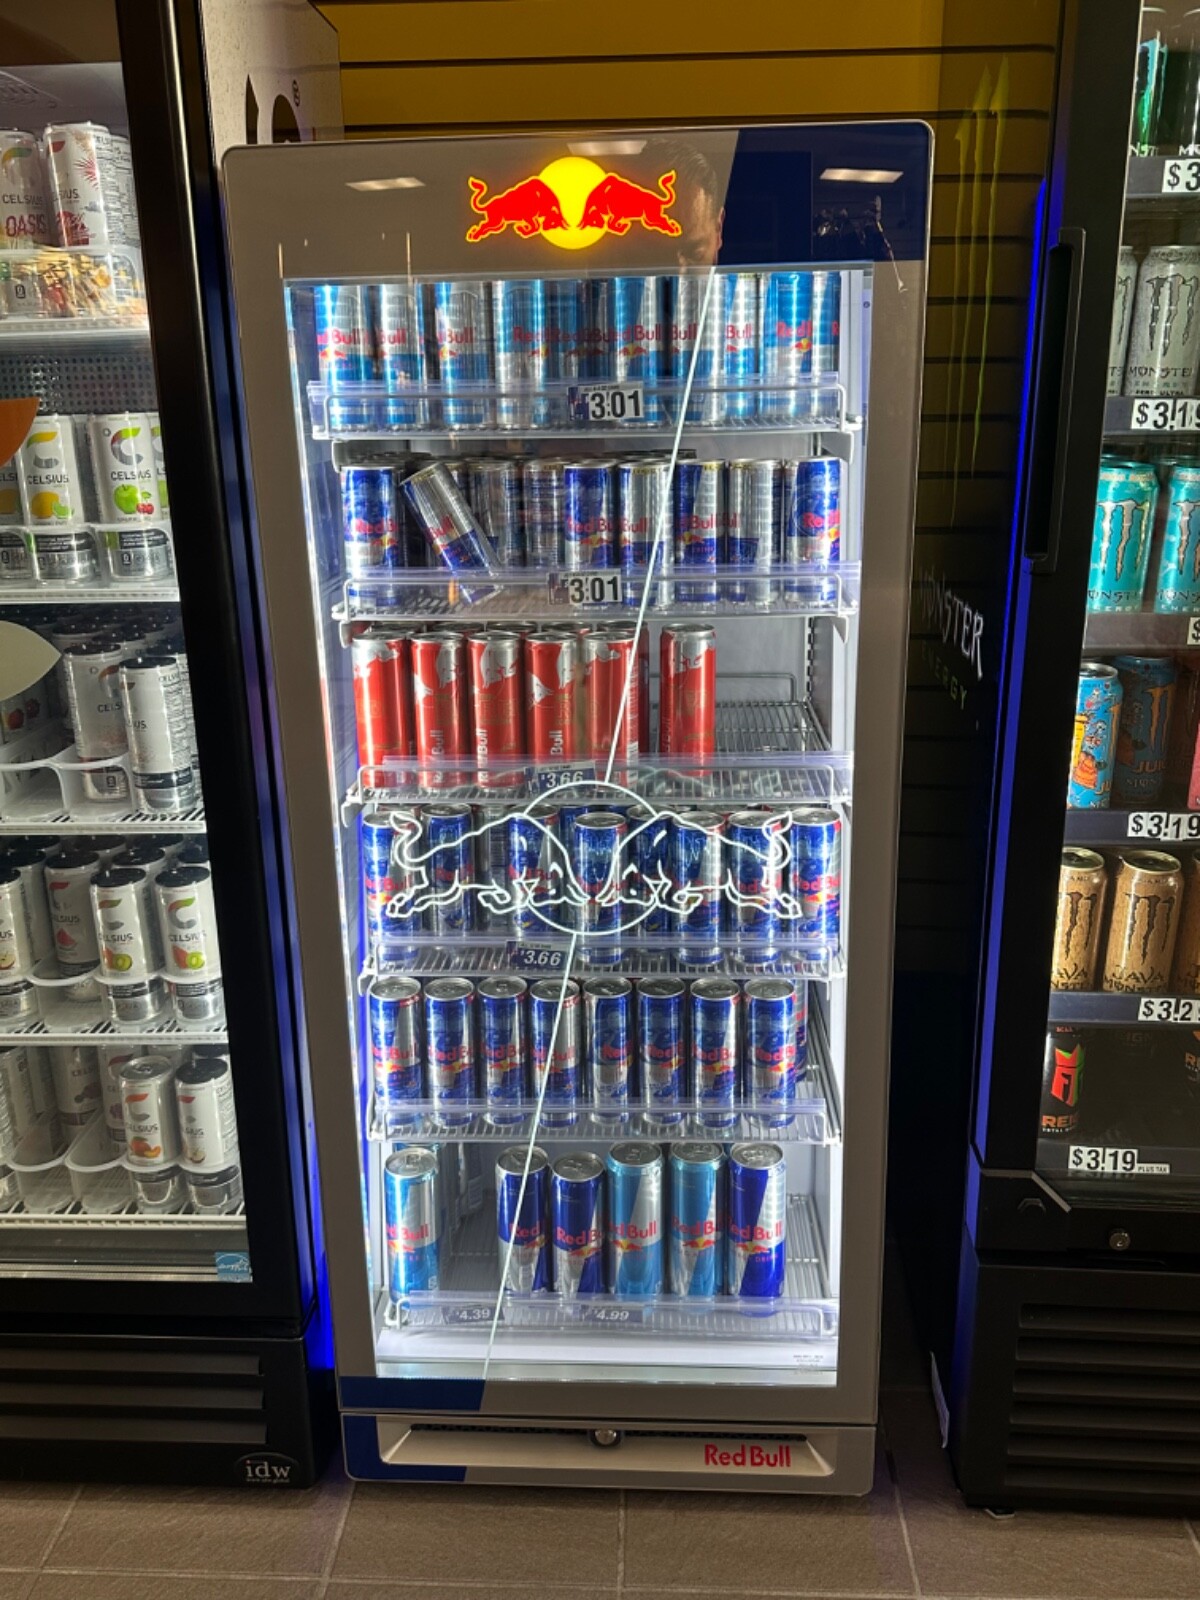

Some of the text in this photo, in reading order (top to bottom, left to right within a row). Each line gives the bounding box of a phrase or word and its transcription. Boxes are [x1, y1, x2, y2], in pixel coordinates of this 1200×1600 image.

[6, 215, 47, 237] OASIS
[556, 1225, 587, 1246] Red
[627, 1220, 657, 1240] Bull
[753, 1221, 783, 1241] Bull
[704, 1443, 791, 1468] Red Bull
[245, 1459, 291, 1479] idw
